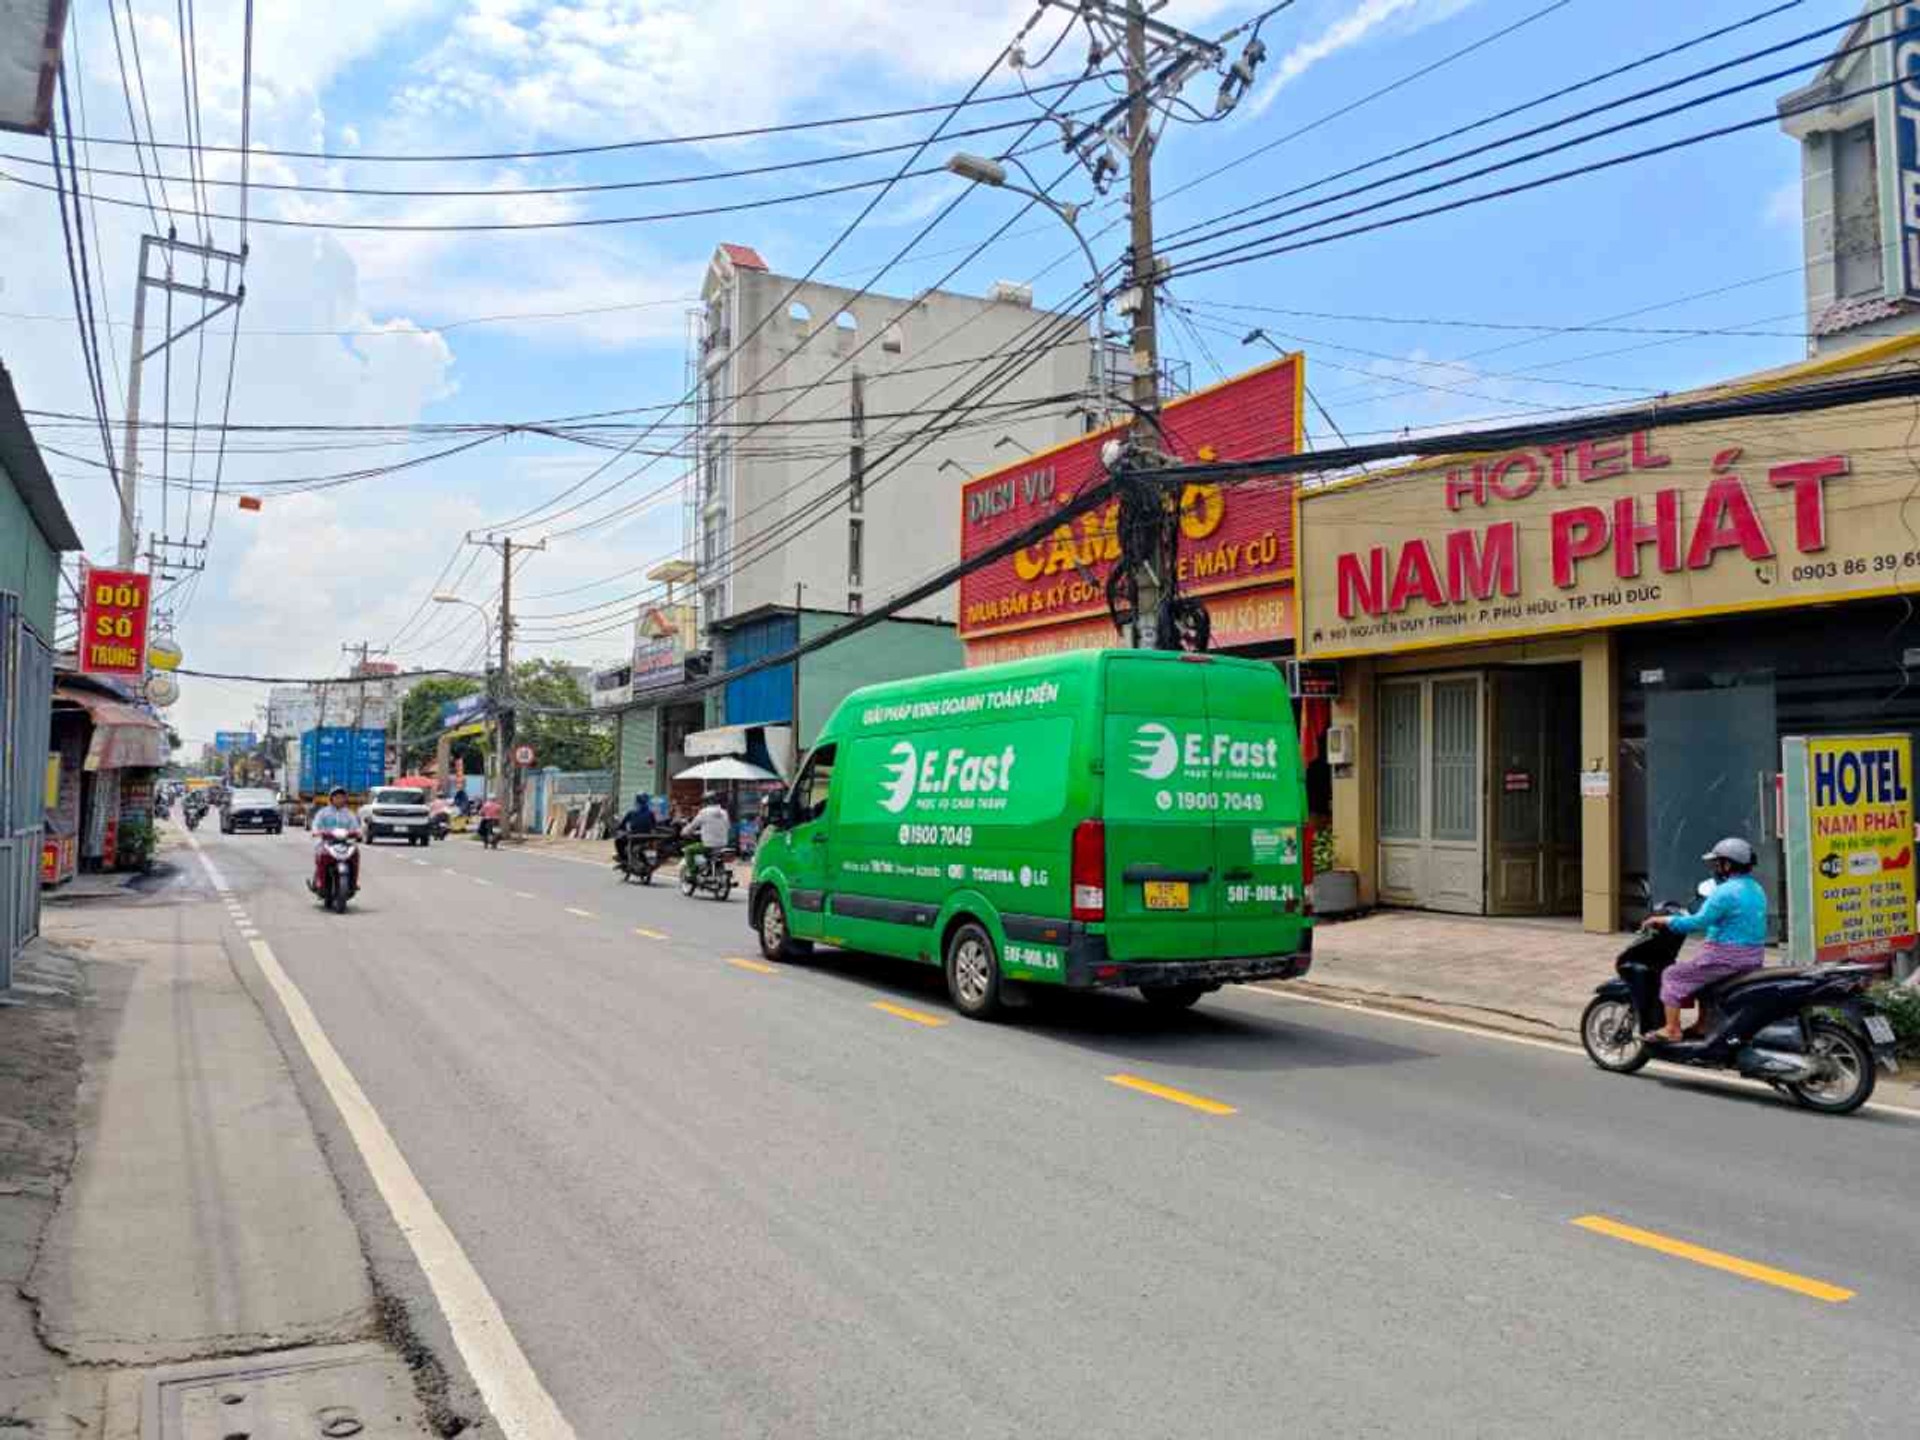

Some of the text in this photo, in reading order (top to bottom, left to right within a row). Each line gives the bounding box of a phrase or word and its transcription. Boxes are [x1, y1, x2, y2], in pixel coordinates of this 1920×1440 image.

[1446, 431, 1670, 510] HOTEL
[969, 466, 1056, 527] DỊCH VỤ
[1336, 447, 1850, 621] NAM PHÁT
[1031, 589, 1044, 613] &
[1194, 540, 1240, 577] MÁY
[1245, 532, 1278, 566] CŨ
[1792, 562, 1838, 582] 0903
[1843, 558, 1867, 575] 86
[1872, 554, 1897, 572] 39
[918, 744, 1015, 793] E.Fast
[1184, 732, 1278, 768] E.Fast
[1814, 747, 1907, 807] HOTEL
[1176, 791, 1264, 811] 1900 7049
[911, 824, 973, 846] 1900 7049
[1818, 814, 1857, 836] NAM
[1033, 870, 1049, 886] LG
